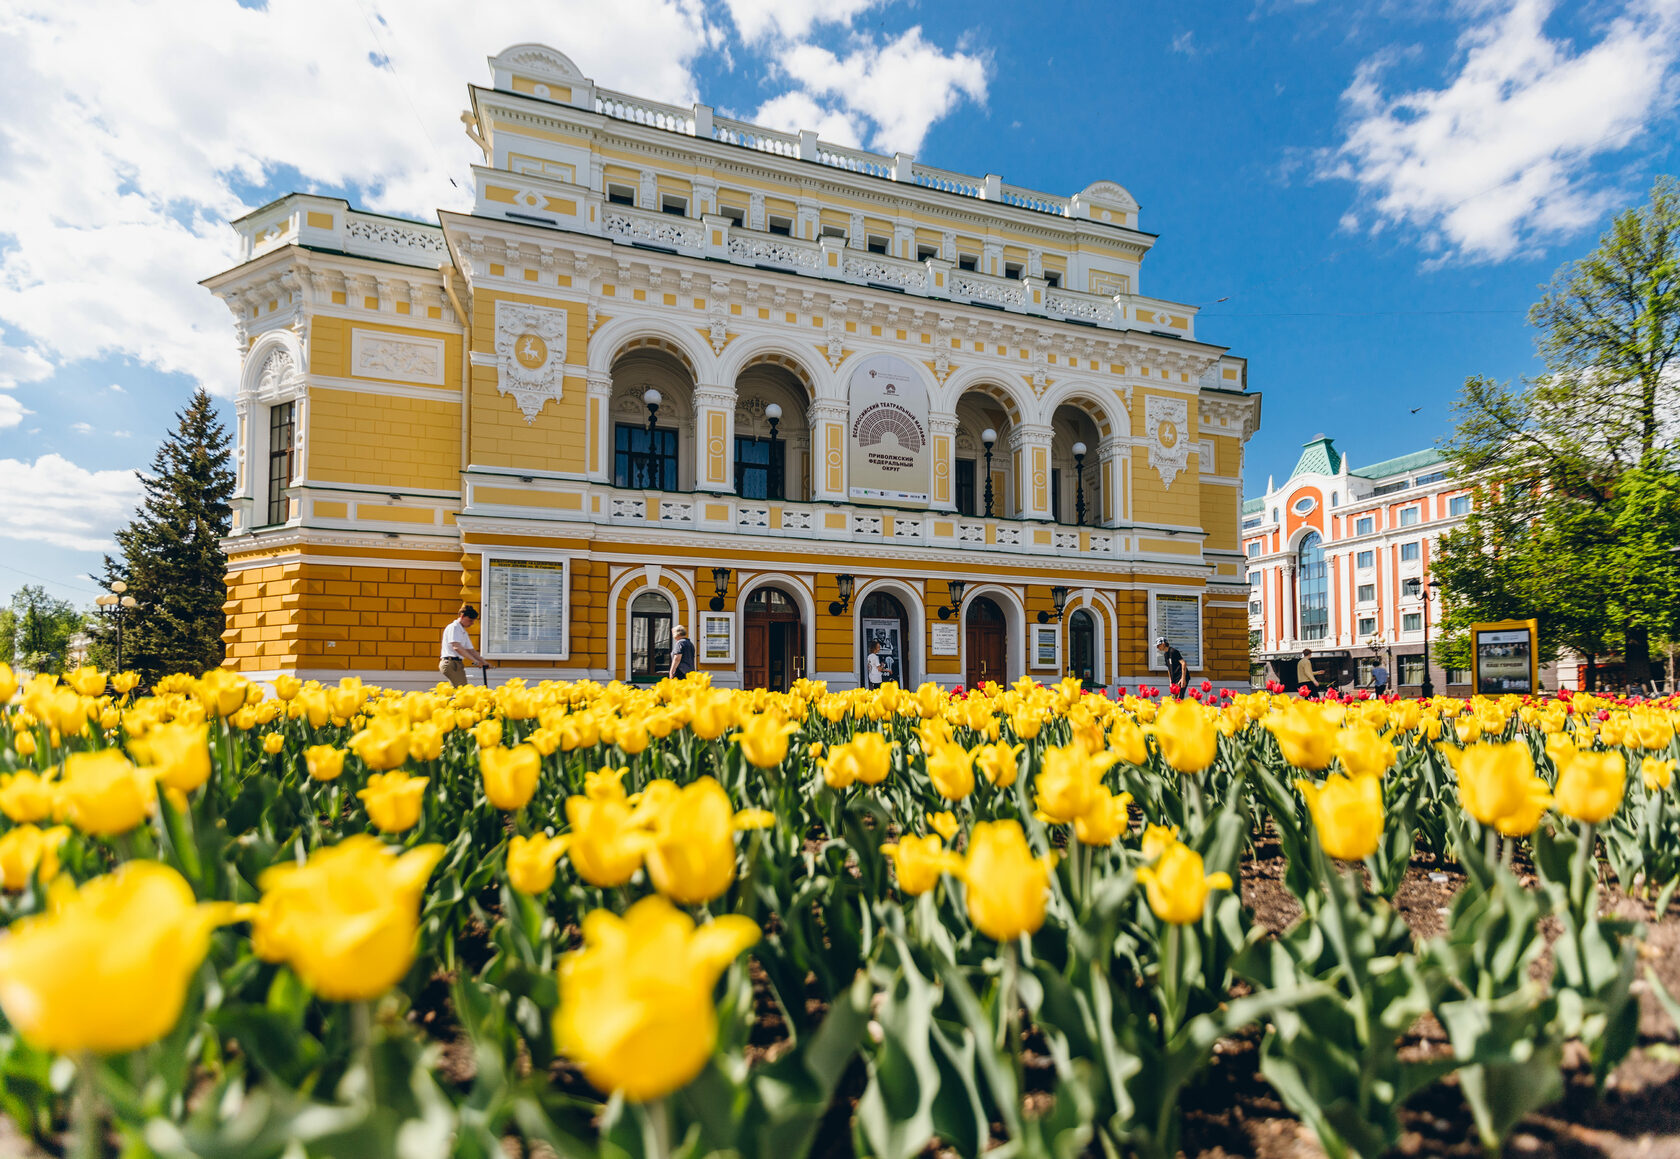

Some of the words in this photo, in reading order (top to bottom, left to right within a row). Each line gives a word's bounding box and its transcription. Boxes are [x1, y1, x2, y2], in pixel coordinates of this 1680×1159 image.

[853, 403, 879, 438] ВСЕРОССИЙСКИЙ
[880, 402, 916, 420] ТЕАТРАЛЬНЫЙ
[914, 420, 926, 445] МАРАФОН
[869, 453, 913, 461] ПРИВОЛЖСКИЙ
[869, 459, 913, 467] ФЕДЕРАЛЬНЫЙ
